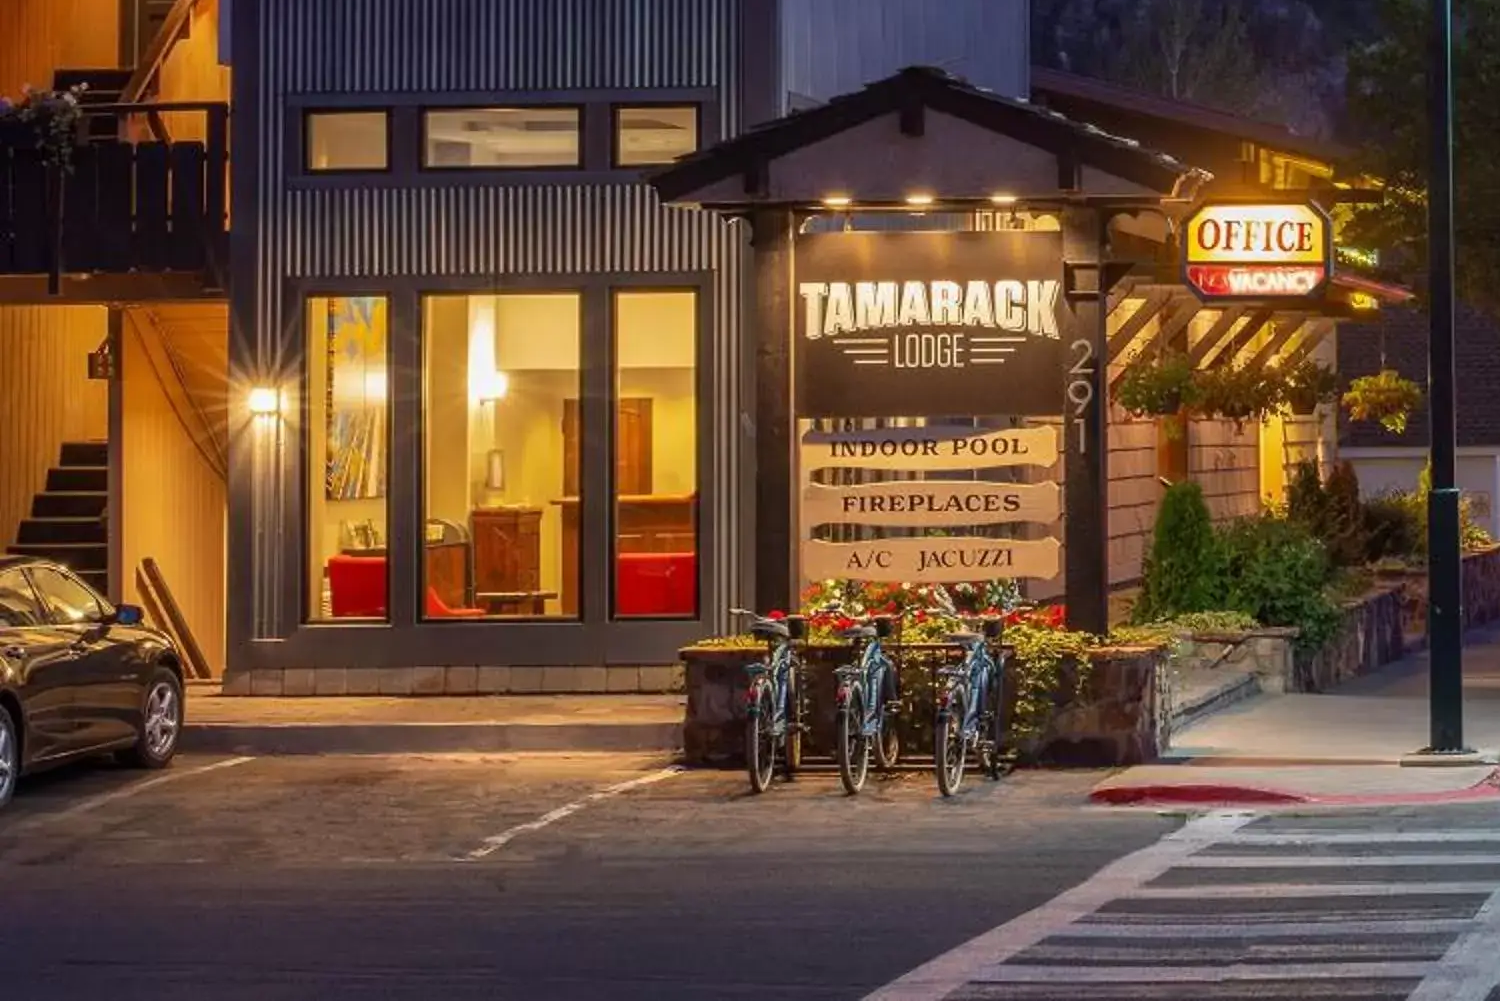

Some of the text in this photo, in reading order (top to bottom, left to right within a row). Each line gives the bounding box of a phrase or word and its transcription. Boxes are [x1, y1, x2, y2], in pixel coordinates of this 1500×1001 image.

[1197, 218, 1313, 252] OFFICE
[1229, 271, 1317, 292] VACANCY
[800, 280, 1061, 340] TAMARACK
[895, 333, 965, 368] LODGE
[1067, 338, 1095, 454] 291
[830, 437, 1029, 458] INDOOR POOL
[842, 494, 1021, 513] FIREPLACES
[847, 548, 1013, 572] A/C JACUZZI
